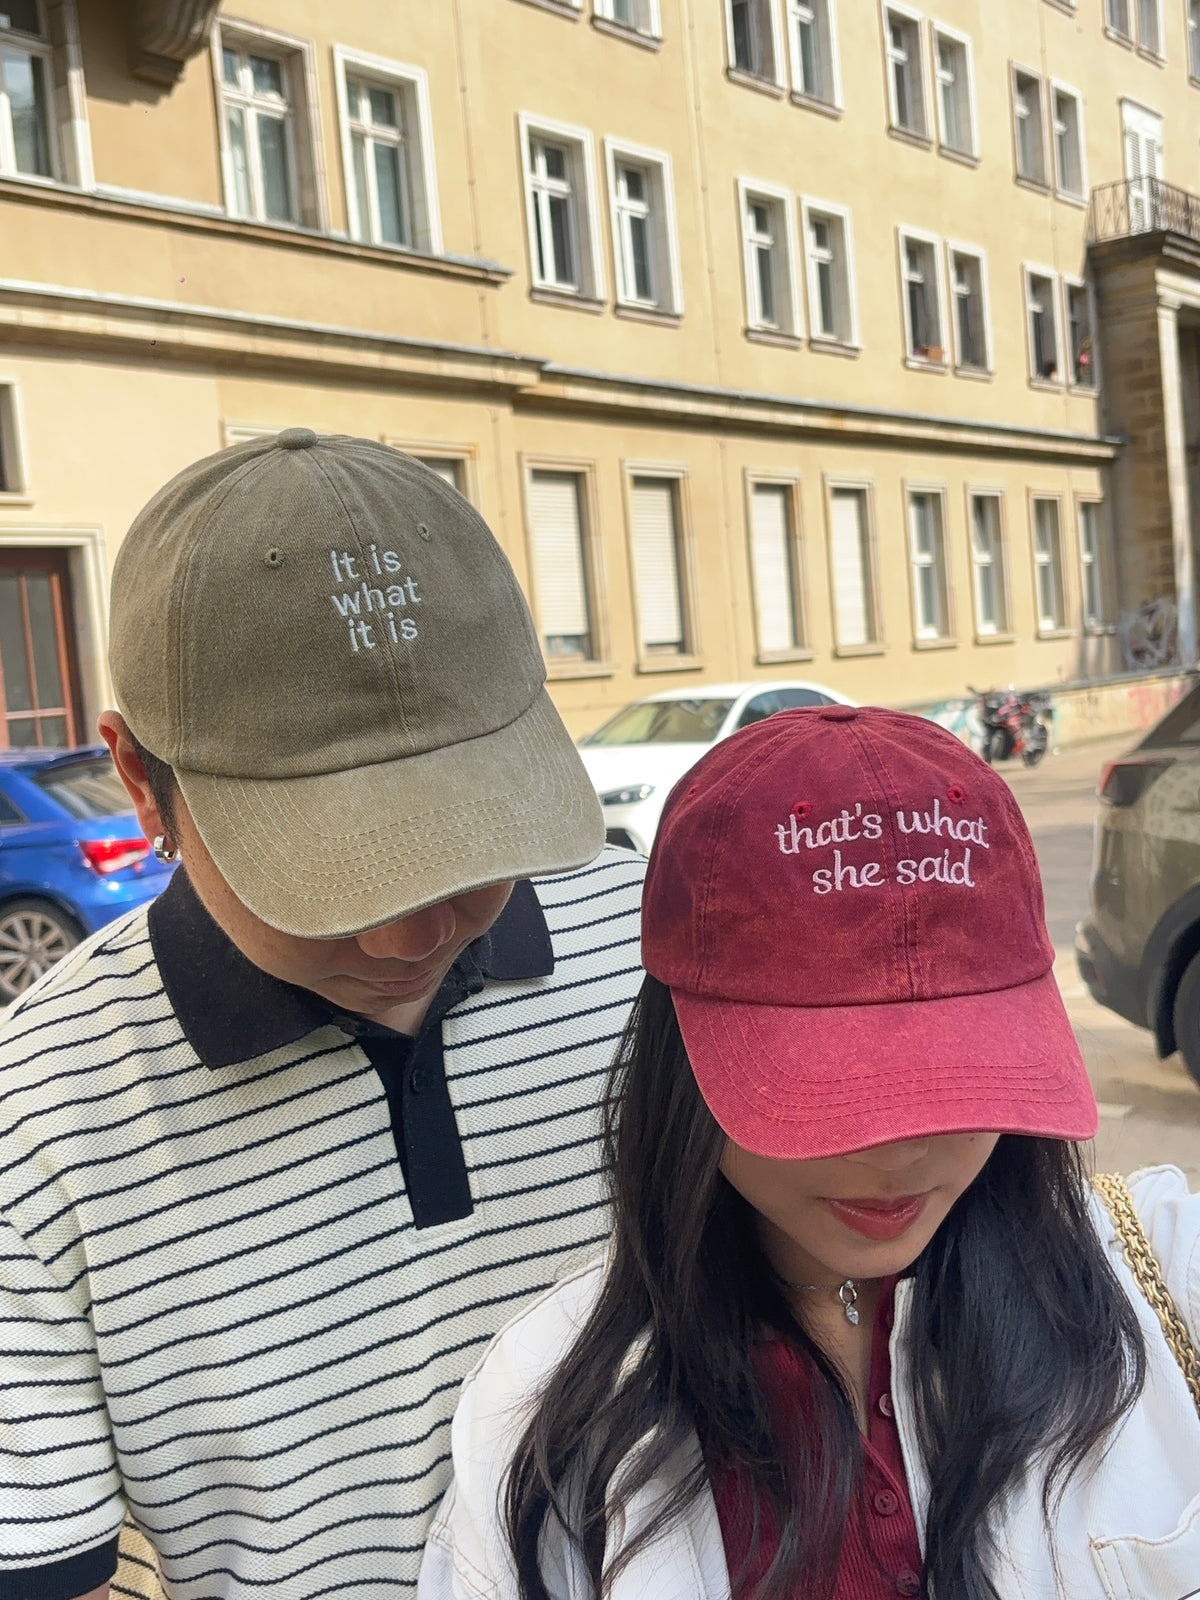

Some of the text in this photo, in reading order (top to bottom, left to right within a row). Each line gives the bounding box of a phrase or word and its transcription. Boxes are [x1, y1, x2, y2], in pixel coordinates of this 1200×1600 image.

[370, 544, 401, 575] is
[331, 576, 421, 616] what
[348, 612, 418, 652] it is
[774, 798, 990, 854] that's what
[812, 847, 976, 894] she said
